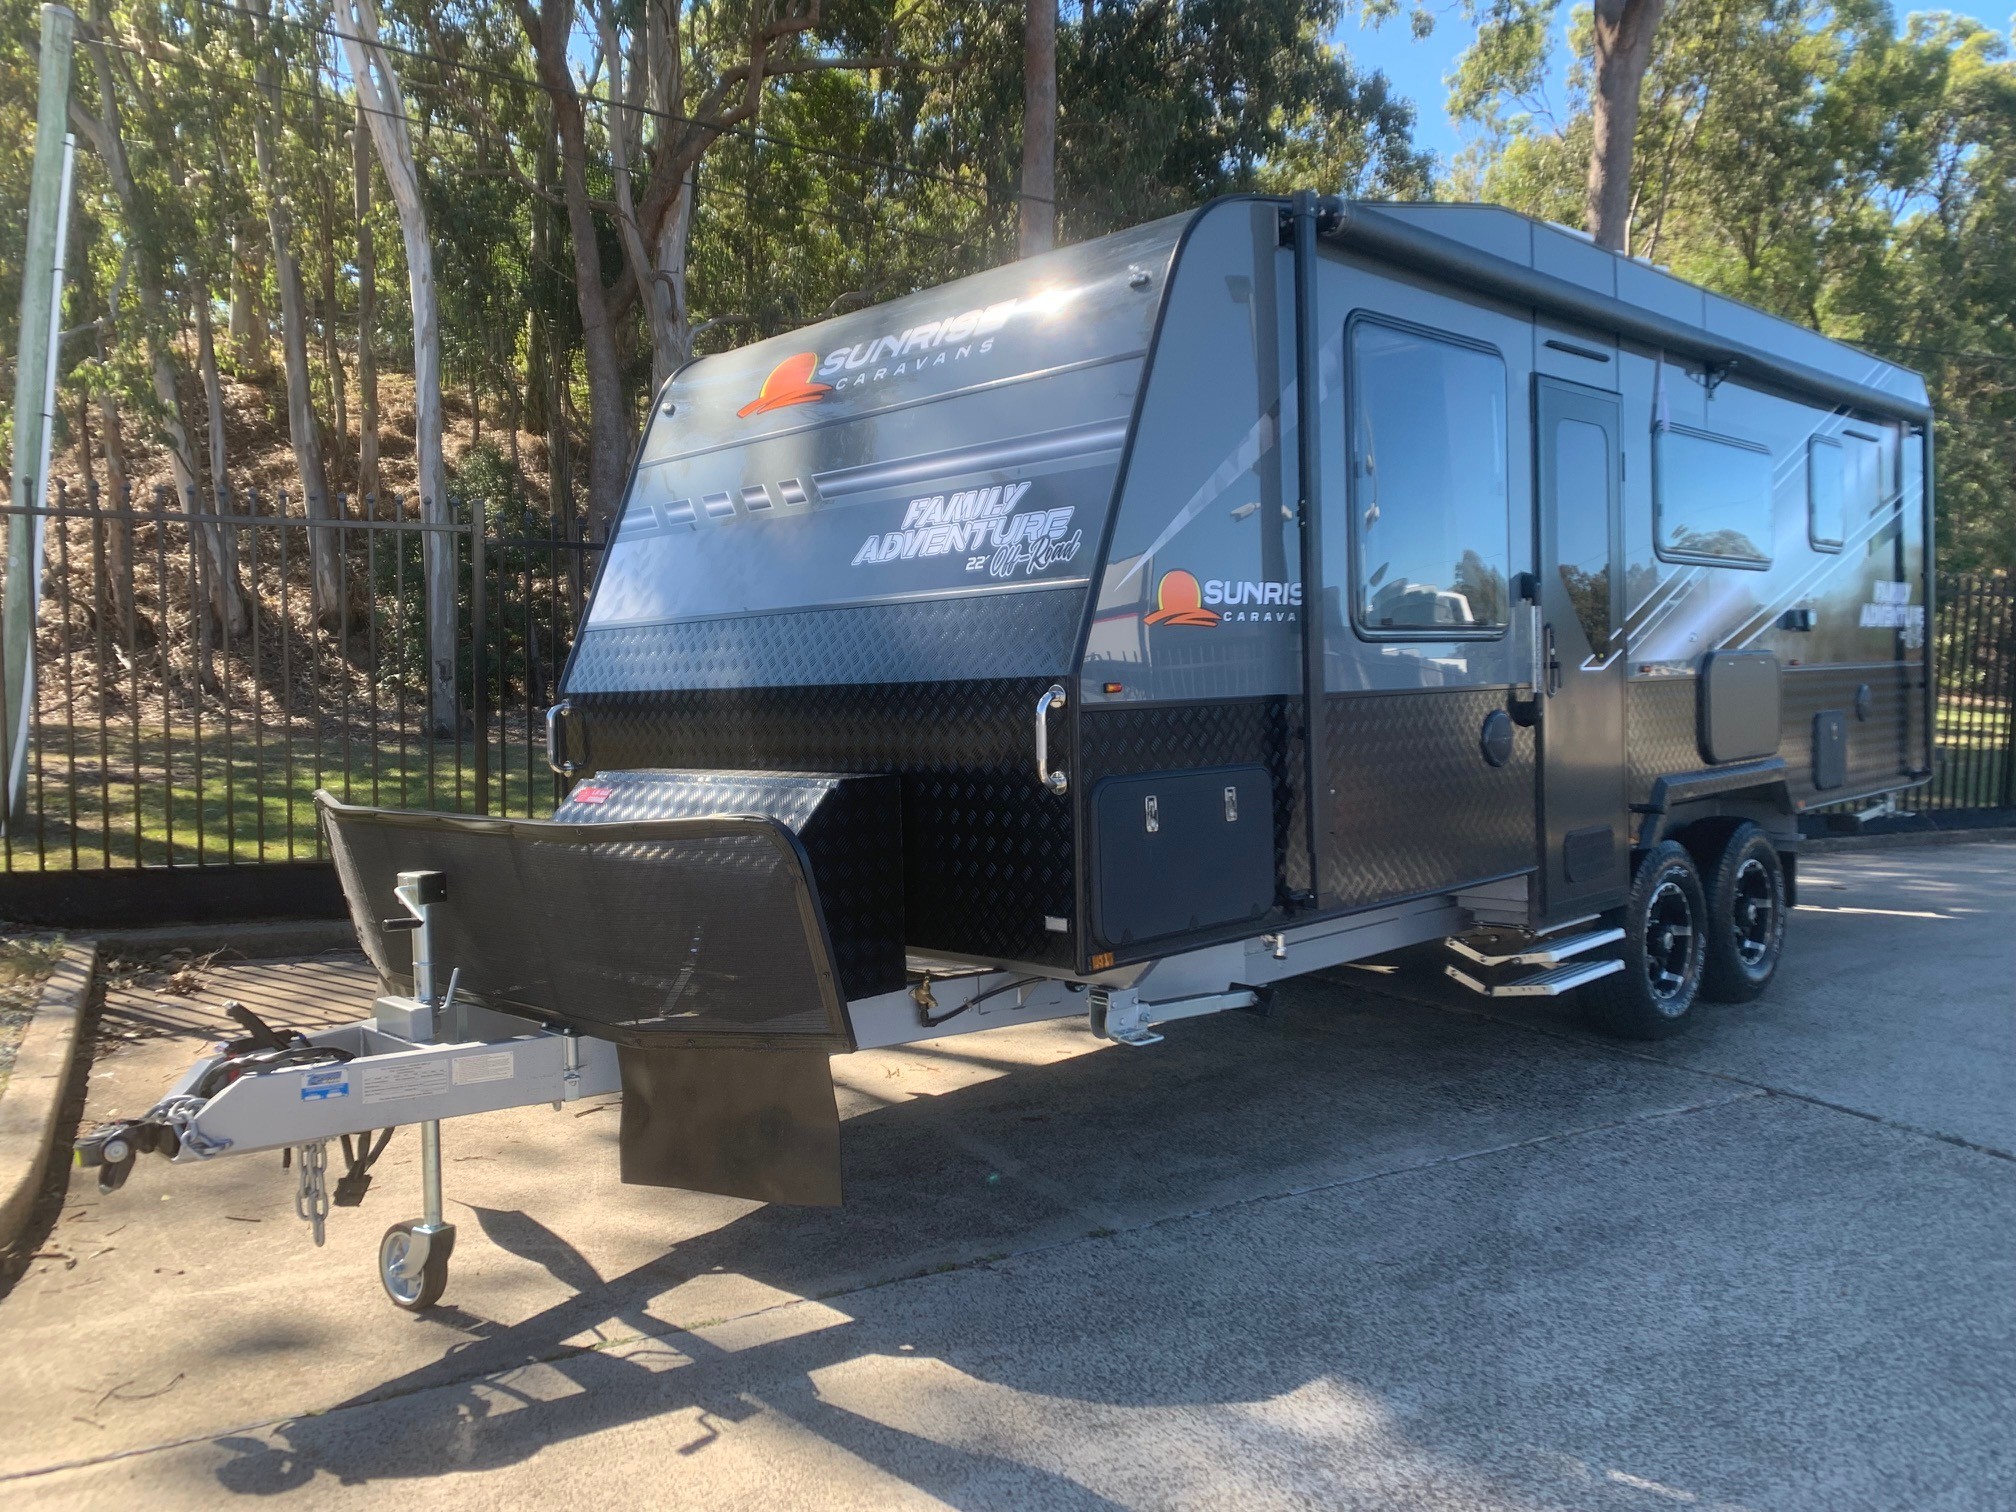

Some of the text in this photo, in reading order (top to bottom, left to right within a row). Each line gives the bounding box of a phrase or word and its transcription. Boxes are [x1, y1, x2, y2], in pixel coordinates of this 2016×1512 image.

[834, 337, 995, 391] CARAVANS
[901, 481, 1031, 530] FAMILY
[851, 506, 1075, 566] ADVENTURE
[990, 529, 1082, 578] Off-Road
[1203, 579, 1303, 606] SUNRIS
[1223, 611, 1297, 622] CARAVA
